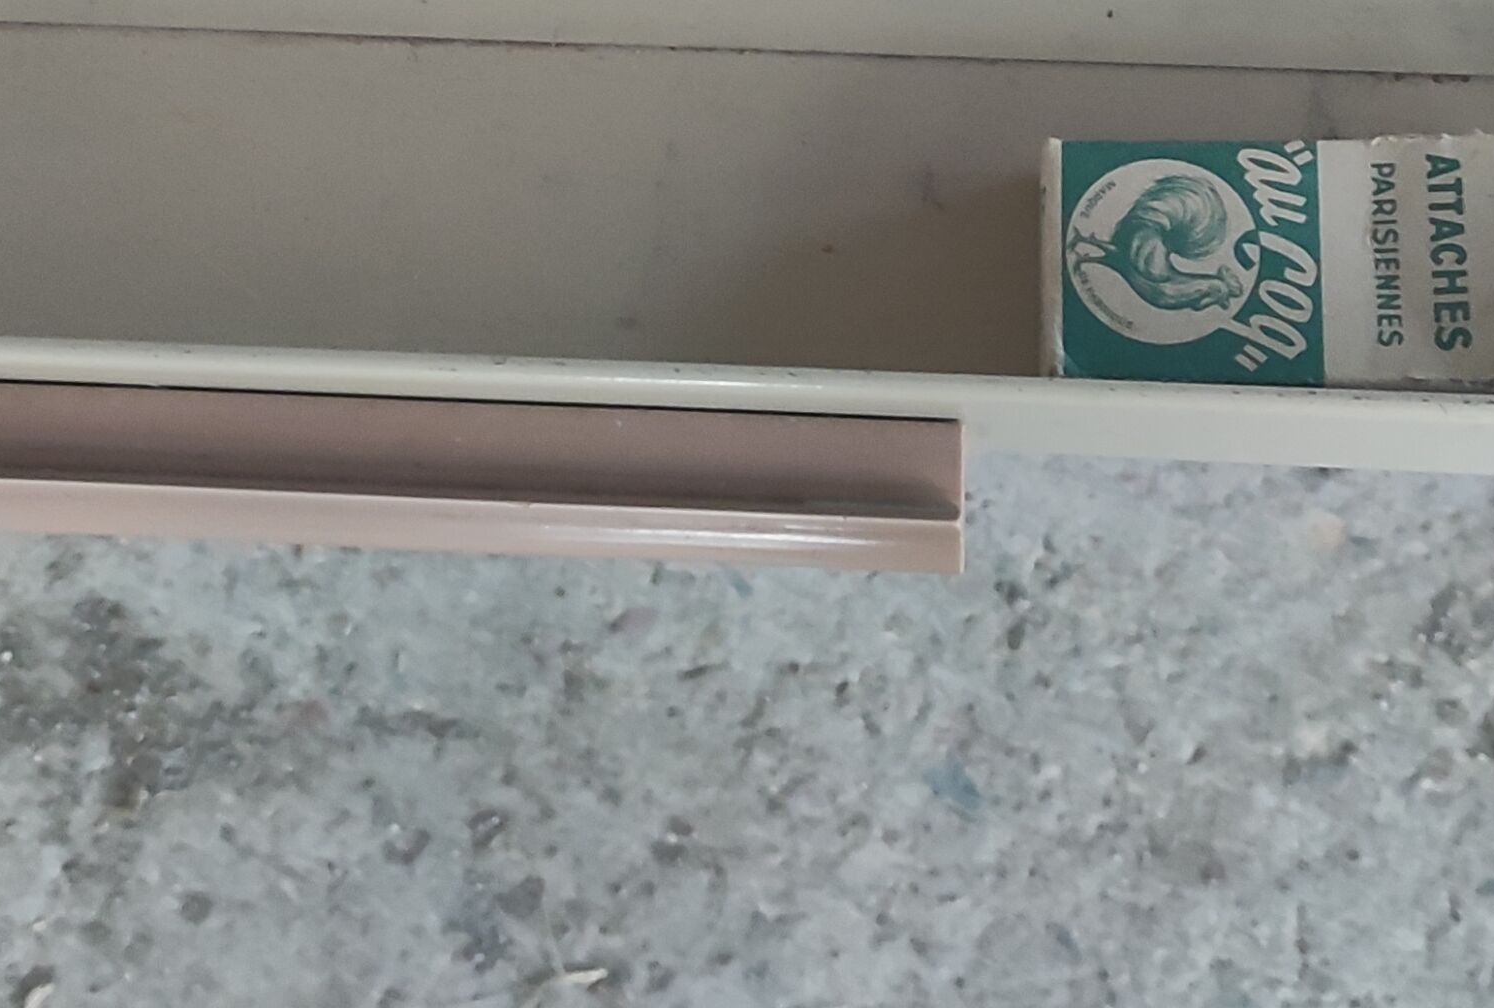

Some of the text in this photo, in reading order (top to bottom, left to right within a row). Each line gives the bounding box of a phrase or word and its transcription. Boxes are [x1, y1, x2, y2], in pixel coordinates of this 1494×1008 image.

[1079, 179, 1117, 220] MARQUE
[1370, 161, 1404, 349] PARISIENNES
[1424, 152, 1473, 353] ATTACHES
